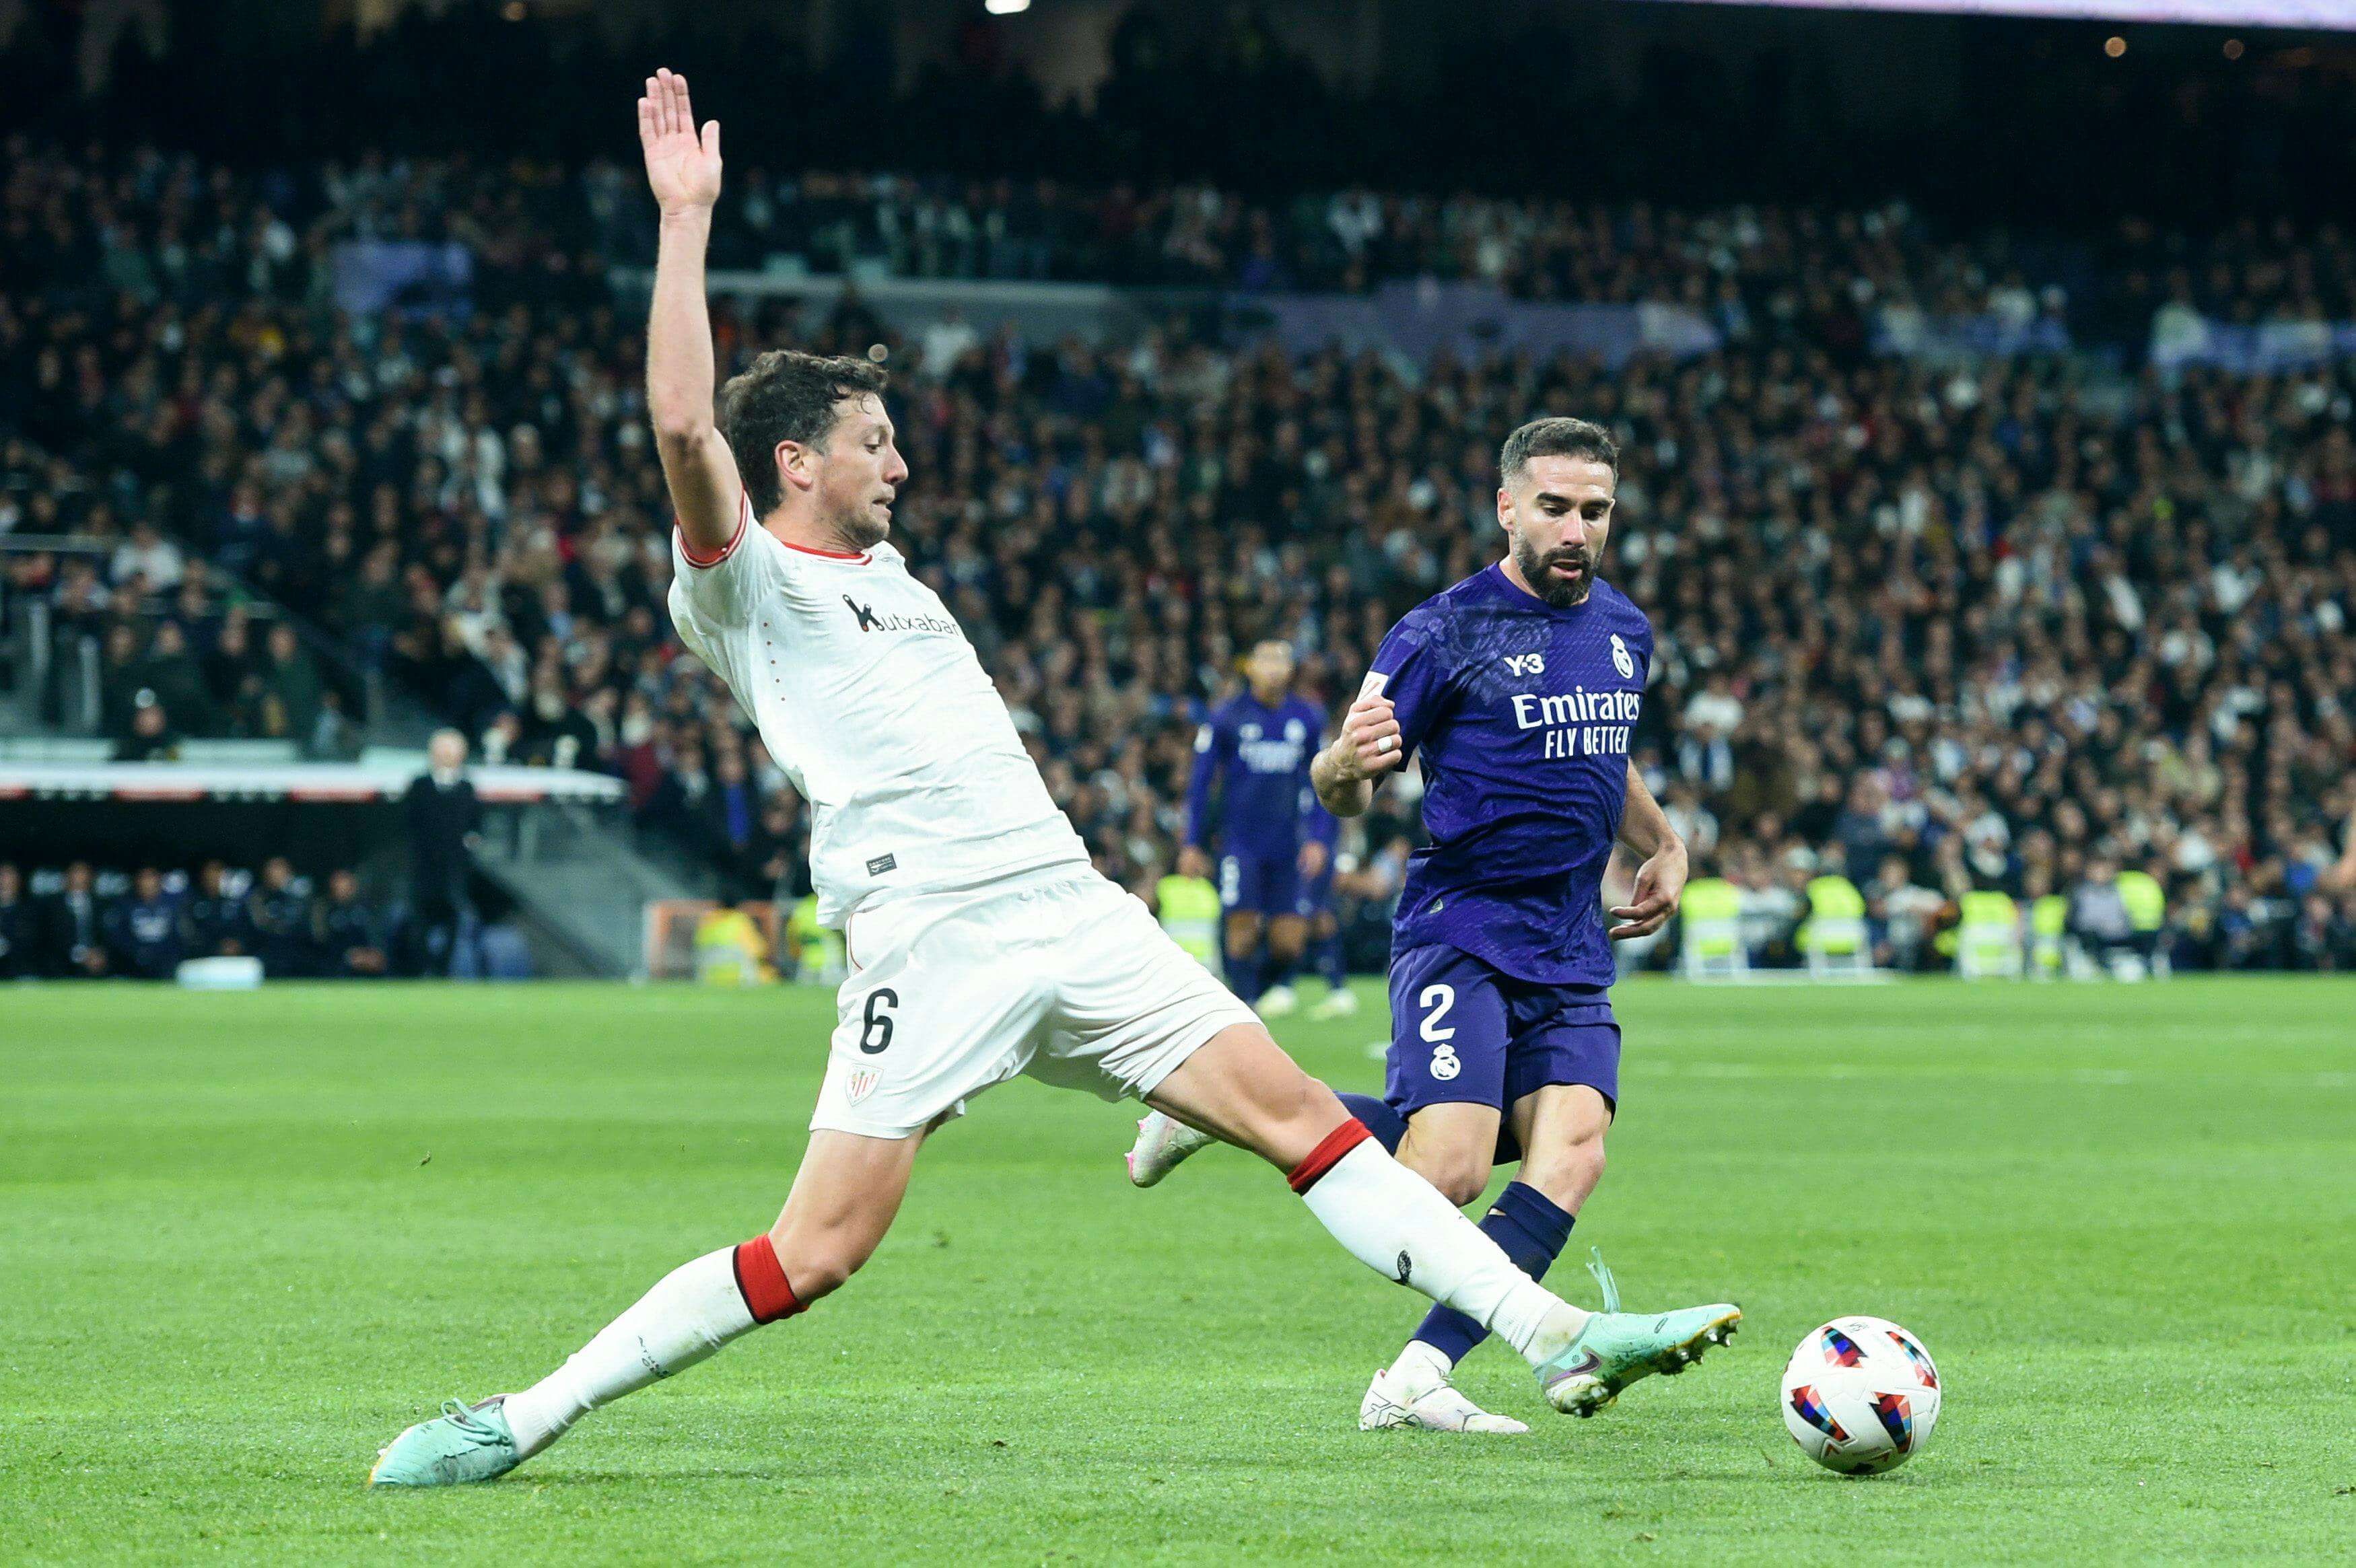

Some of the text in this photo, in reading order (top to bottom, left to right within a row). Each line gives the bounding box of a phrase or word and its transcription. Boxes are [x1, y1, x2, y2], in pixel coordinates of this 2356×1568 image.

[1511, 685, 1640, 730] Emirates
[1545, 725, 1630, 759] FLY BETTER
[860, 988, 899, 1055] 6
[1420, 984, 1456, 1042] 2
